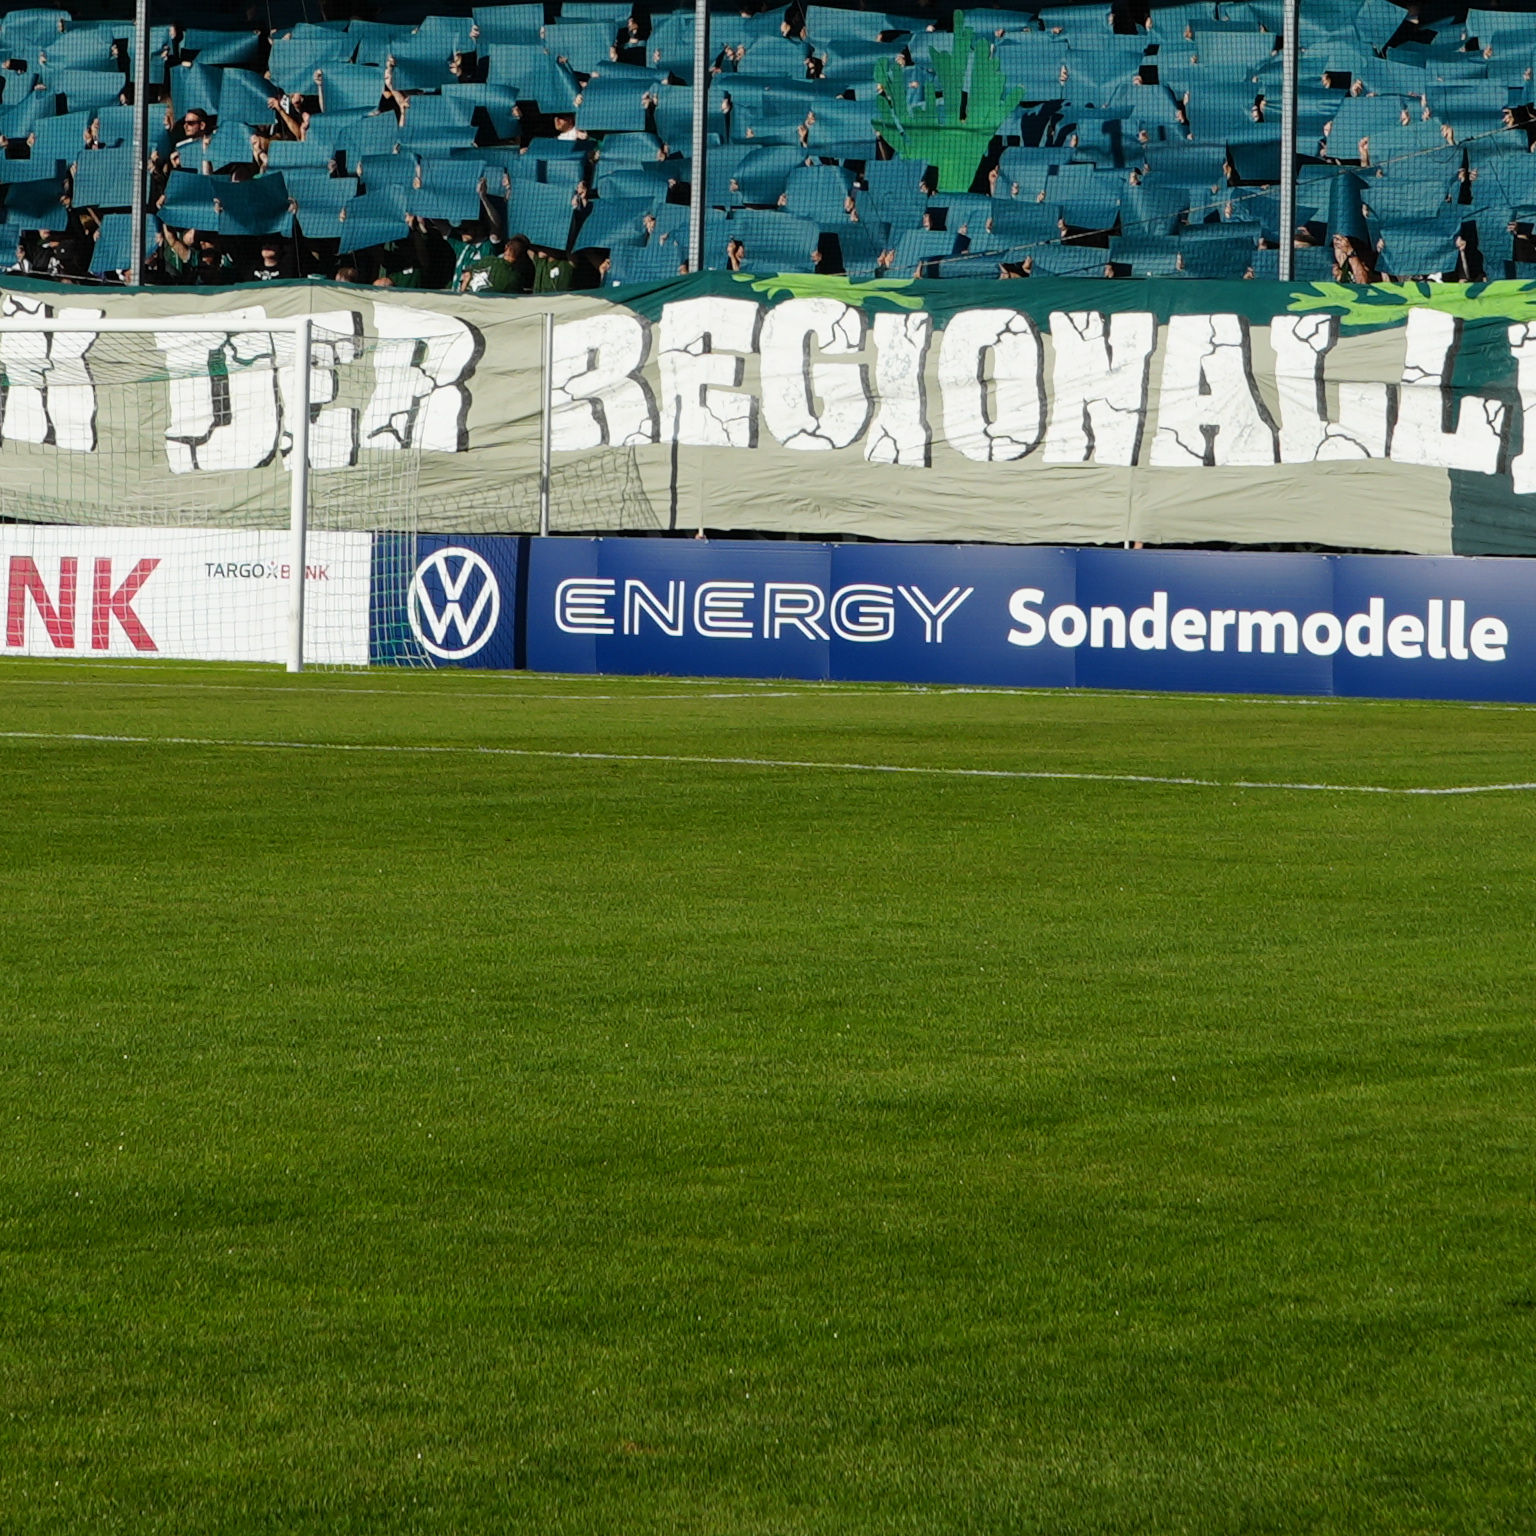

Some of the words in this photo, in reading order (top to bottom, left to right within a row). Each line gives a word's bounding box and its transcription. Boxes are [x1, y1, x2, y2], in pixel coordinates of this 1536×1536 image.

[154, 302, 484, 474] DER
[280, 564, 330, 581] BNK
[555, 578, 974, 644] ENERGY
[1007, 587, 1509, 662] Sondermodelle
